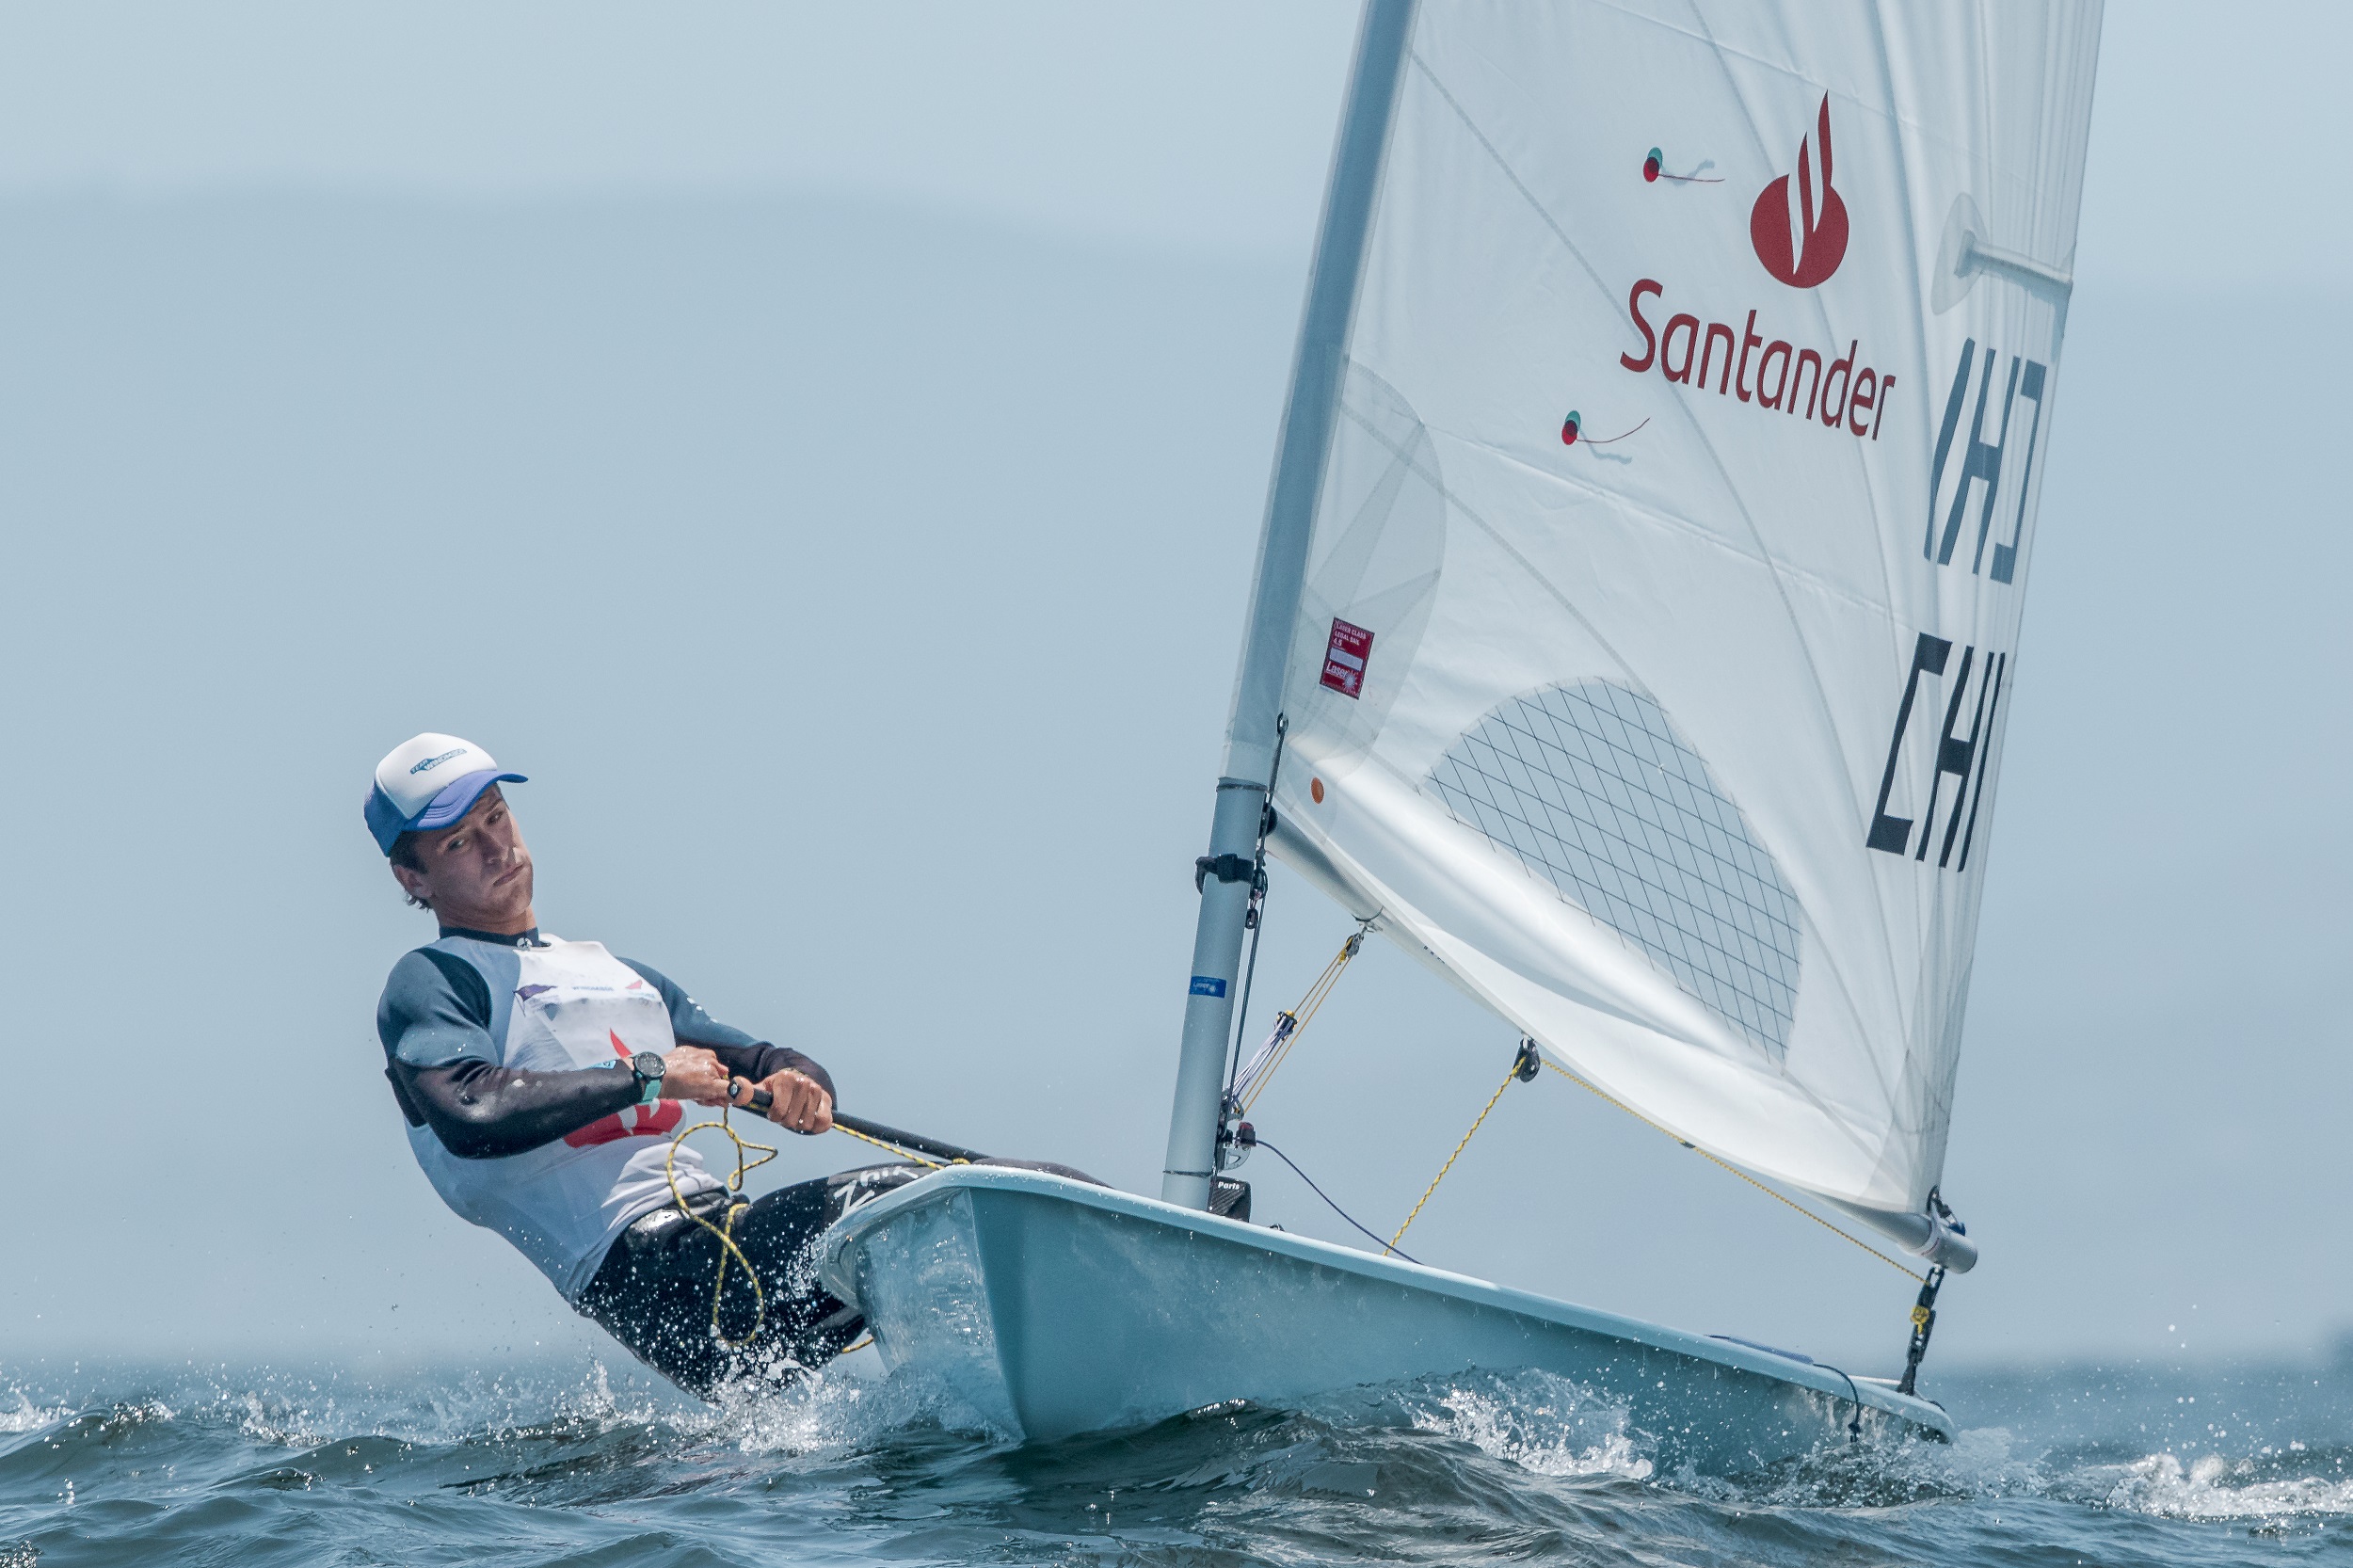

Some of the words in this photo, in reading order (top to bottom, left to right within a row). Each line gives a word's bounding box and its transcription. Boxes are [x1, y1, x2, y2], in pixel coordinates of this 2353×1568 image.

[1619, 278, 1897, 440] Santander
[1326, 661, 1348, 680] Laser
[1865, 632, 2006, 872] CHI
[1218, 1181, 1241, 1190] Paris
